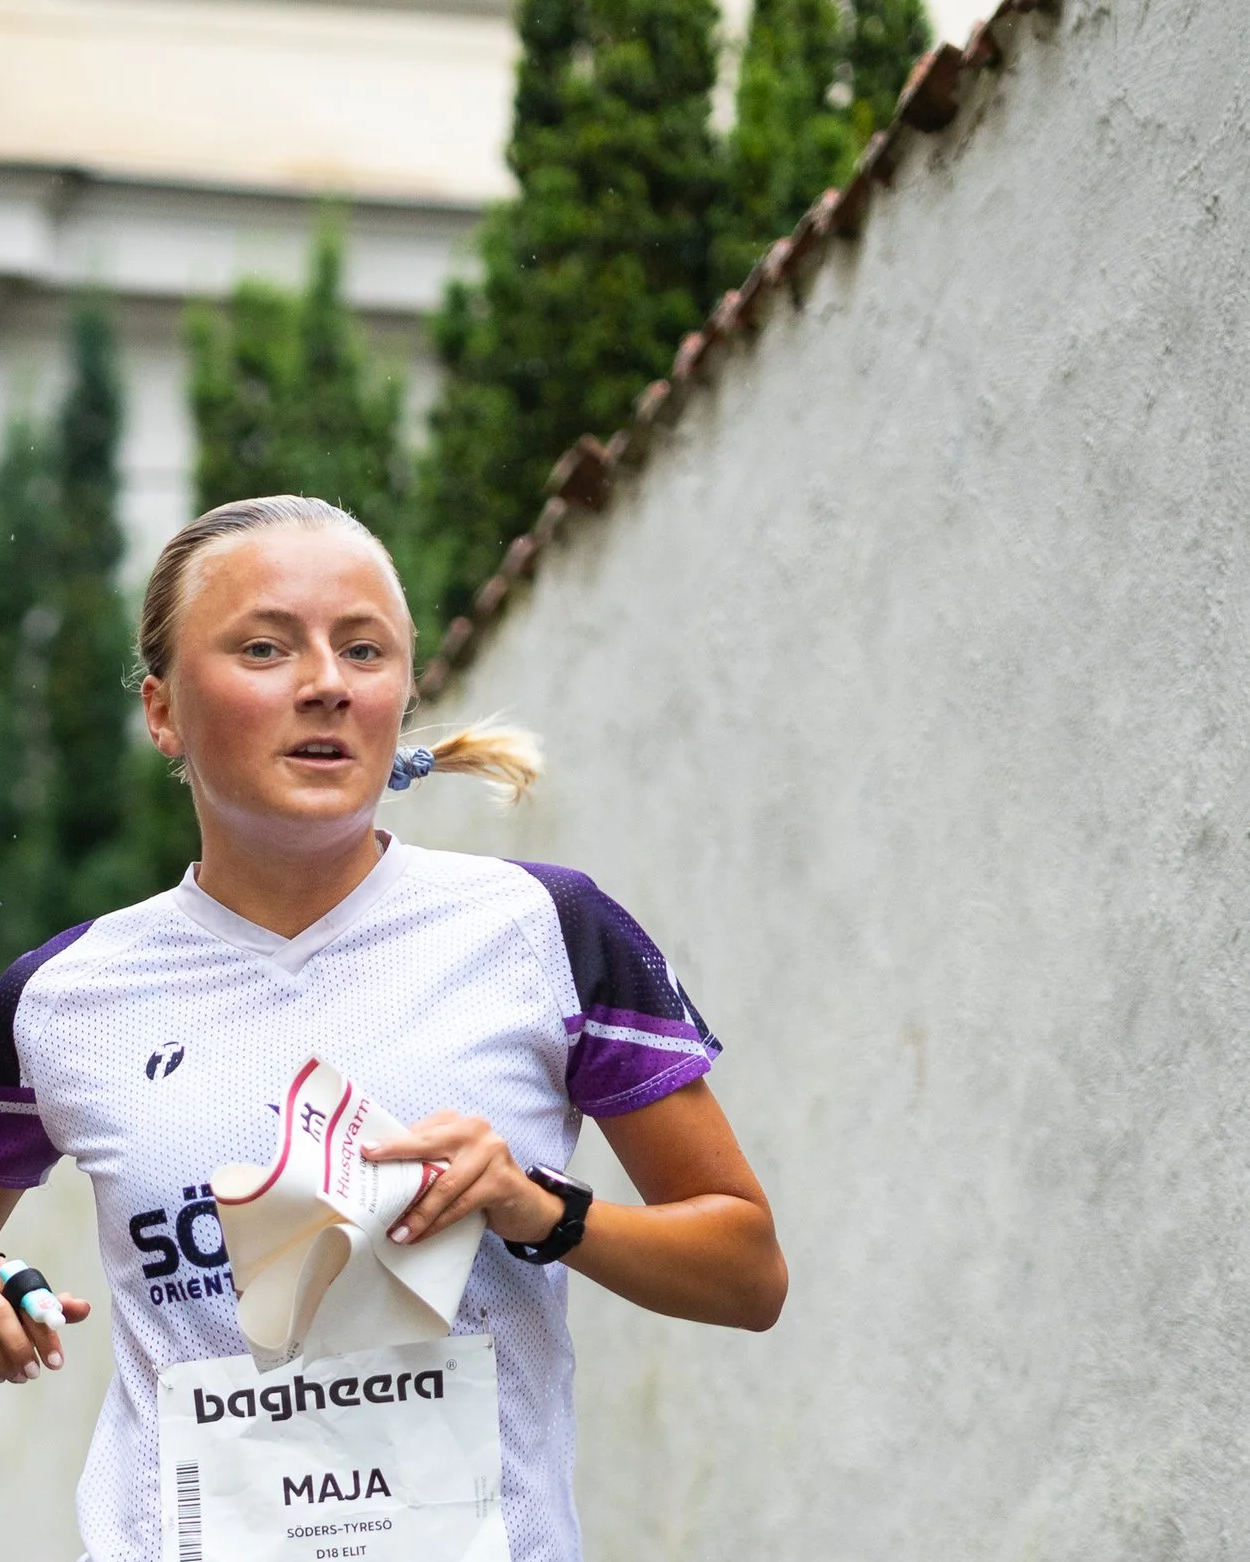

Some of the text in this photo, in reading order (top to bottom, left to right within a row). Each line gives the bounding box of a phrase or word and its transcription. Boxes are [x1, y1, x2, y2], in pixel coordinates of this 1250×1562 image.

[282, 1467, 392, 1507] MAJA
[286, 1517, 393, 1539] SÖDERS-TYRESÖ
[316, 1544, 367, 1560] D18 ELIT
